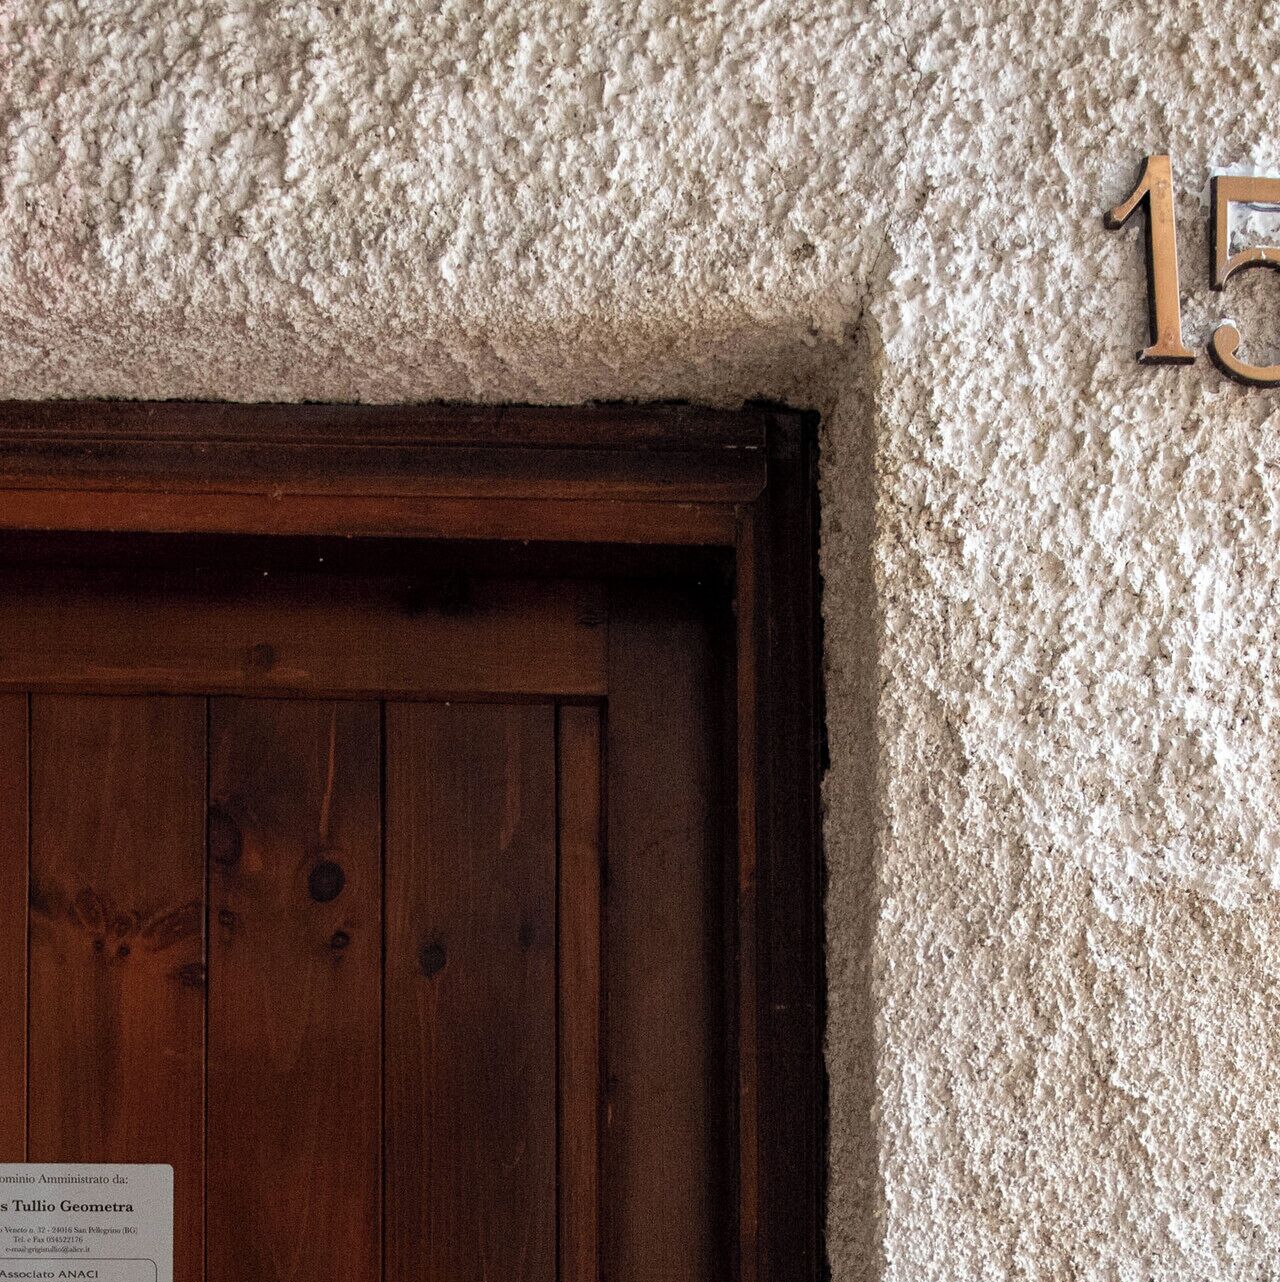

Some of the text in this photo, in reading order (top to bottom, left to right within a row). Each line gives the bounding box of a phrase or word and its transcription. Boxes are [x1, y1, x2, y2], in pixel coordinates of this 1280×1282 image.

[38, 1173, 110, 1185] Amministrato
[112, 1174, 129, 1185] da:
[12, 1199, 56, 1212] Tullio
[60, 1199, 134, 1213] Geometra
[4, 1225, 28, 1233] Veneto
[74, 1226, 87, 1234] San
[0, 1270, 99, 1279] Associato ANACI
